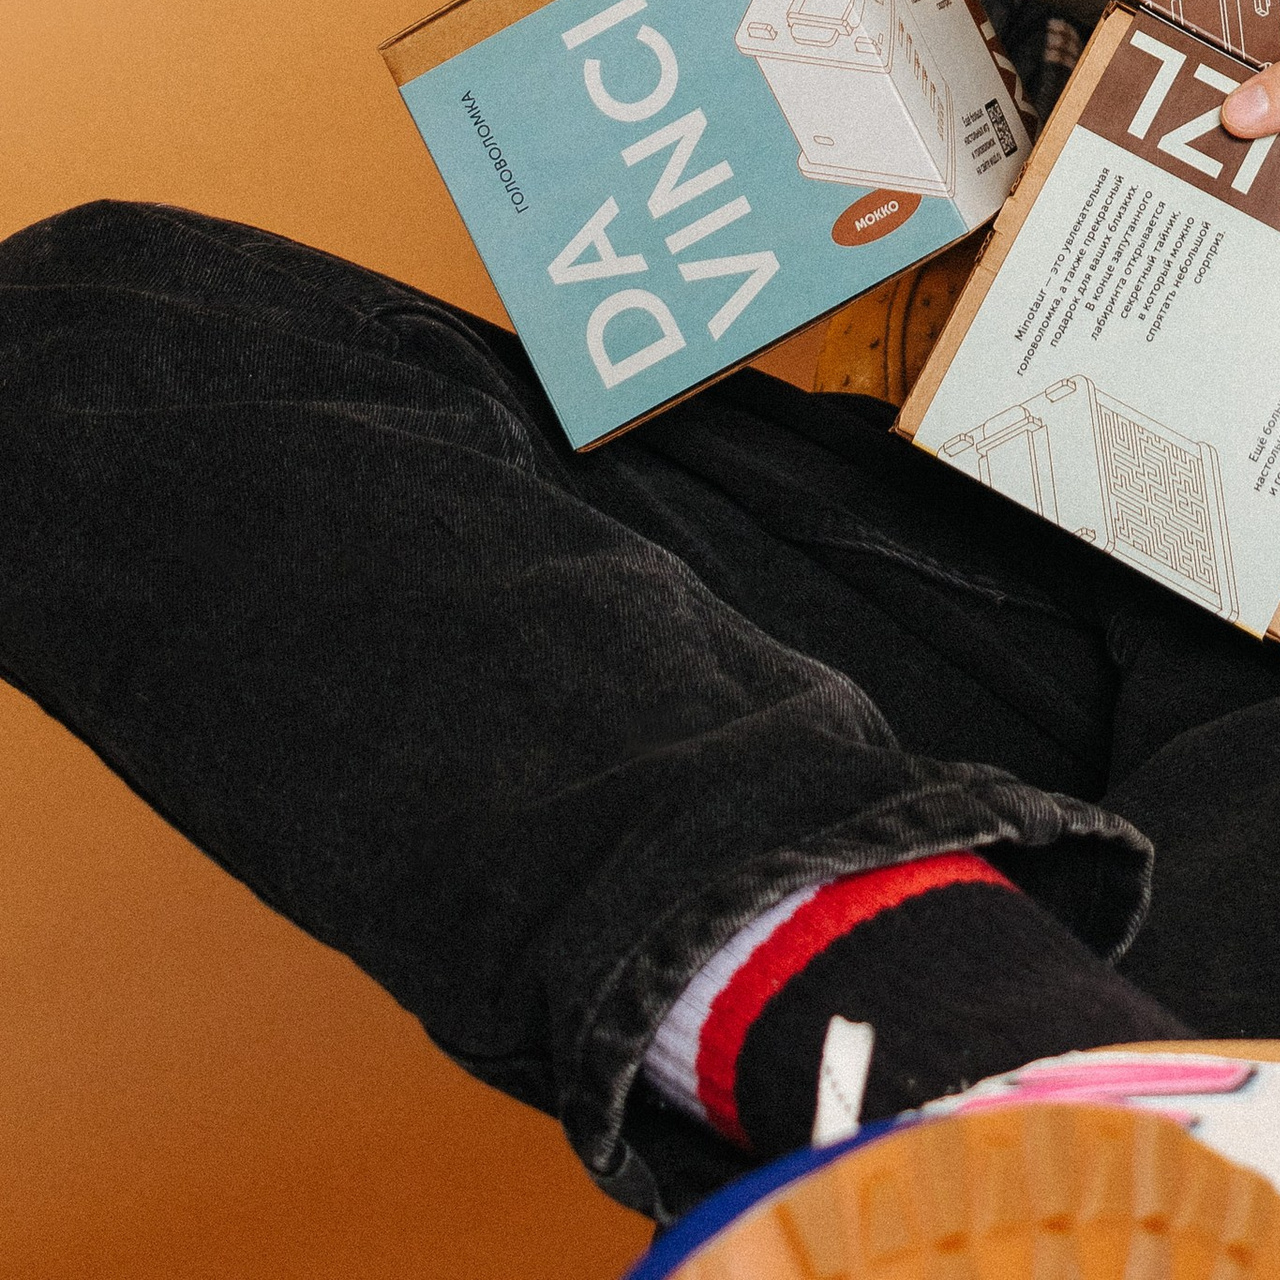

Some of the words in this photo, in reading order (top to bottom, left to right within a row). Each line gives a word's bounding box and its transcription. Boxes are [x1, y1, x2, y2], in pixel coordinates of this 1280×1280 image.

[461, 89, 529, 214] ГОЛОВОЛОМКА
[854, 199, 900, 232] МОККО
[1014, 288, 1046, 342] Minotaur
[1050, 253, 1065, 275] это
[1061, 167, 1110, 254] увлекательная
[1016, 297, 1063, 376] головоломка,
[1059, 285, 1067, 294] а
[1063, 248, 1086, 283] также
[1083, 175, 1124, 247] прекрасный
[1050, 296, 1080, 347] подарок
[1077, 272, 1092, 296] для
[1089, 234, 1112, 271] ваших
[1107, 185, 1137, 232] близких.
[1084, 301, 1095, 312] В
[1092, 264, 1115, 301] конце
[1111, 190, 1153, 264] запутанного
[1091, 277, 1127, 341] лабиринта
[1123, 200, 1166, 275] открывается
[1120, 255, 1157, 319] секретный
[1153, 211, 1181, 252] тайник,
[1137, 312, 1146, 321] в
[1142, 259, 1173, 311] который
[1169, 216, 1195, 258] можно
[1193, 232, 1224, 284] сюрприз.
[546, 195, 688, 390] DA
[1145, 290, 1176, 342] спрятать
[1173, 221, 1211, 288] небольшой
[1248, 437, 1267, 463] Ещё
[1269, 486, 1278, 496] и
